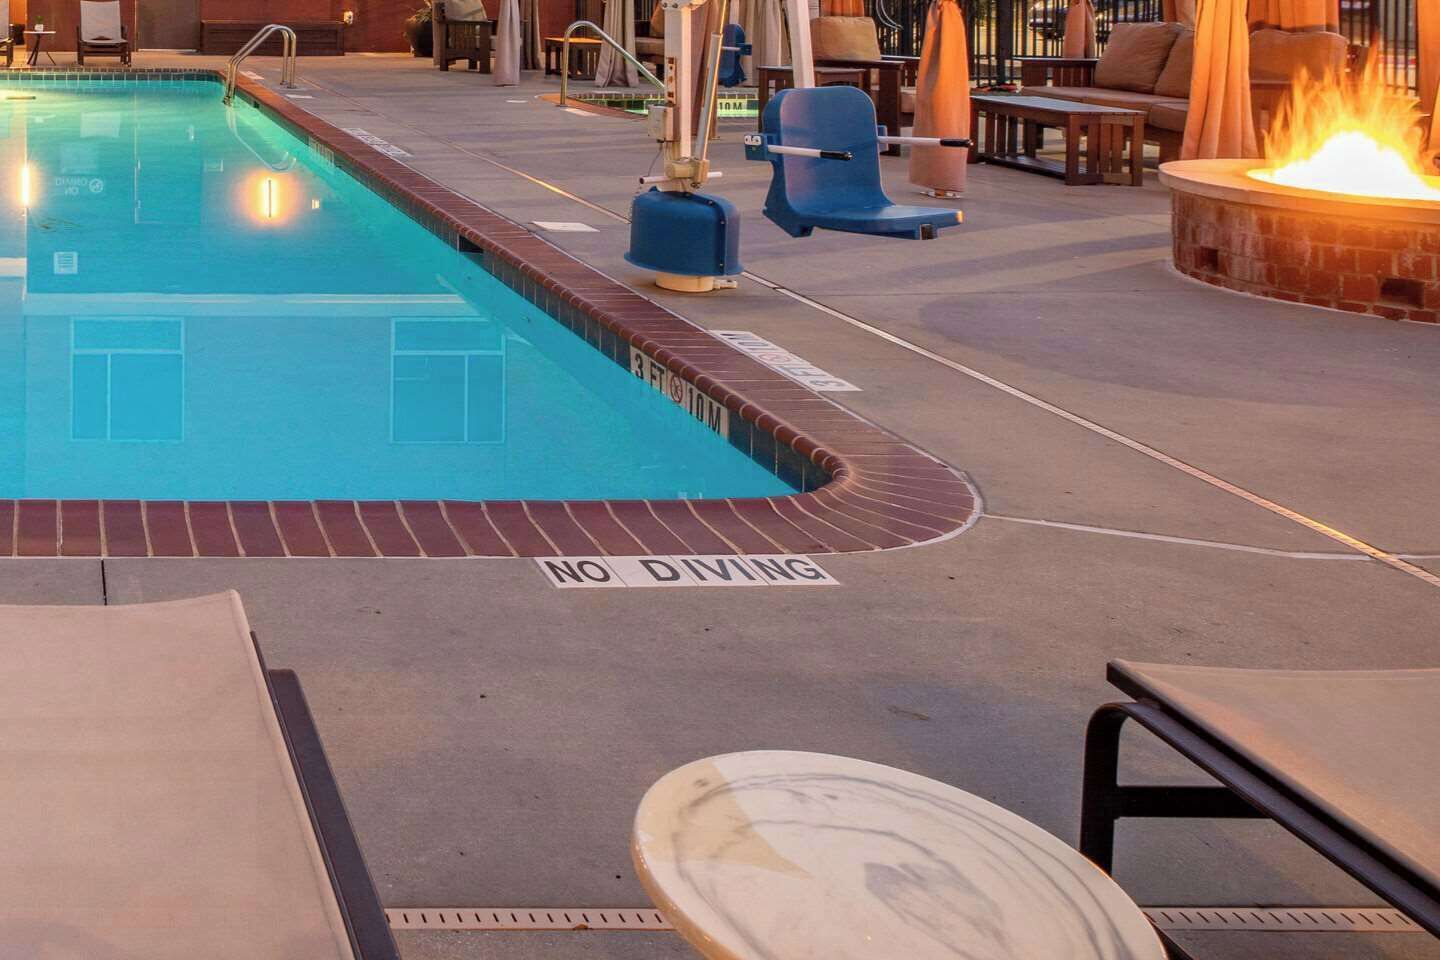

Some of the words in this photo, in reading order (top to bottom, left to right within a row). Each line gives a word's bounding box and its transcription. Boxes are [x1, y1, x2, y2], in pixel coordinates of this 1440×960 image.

[635, 352, 644, 380] 3
[650, 360, 665, 393] FT
[708, 400, 721, 435] M
[544, 559, 612, 583] NO
[638, 558, 827, 582] DIVING
